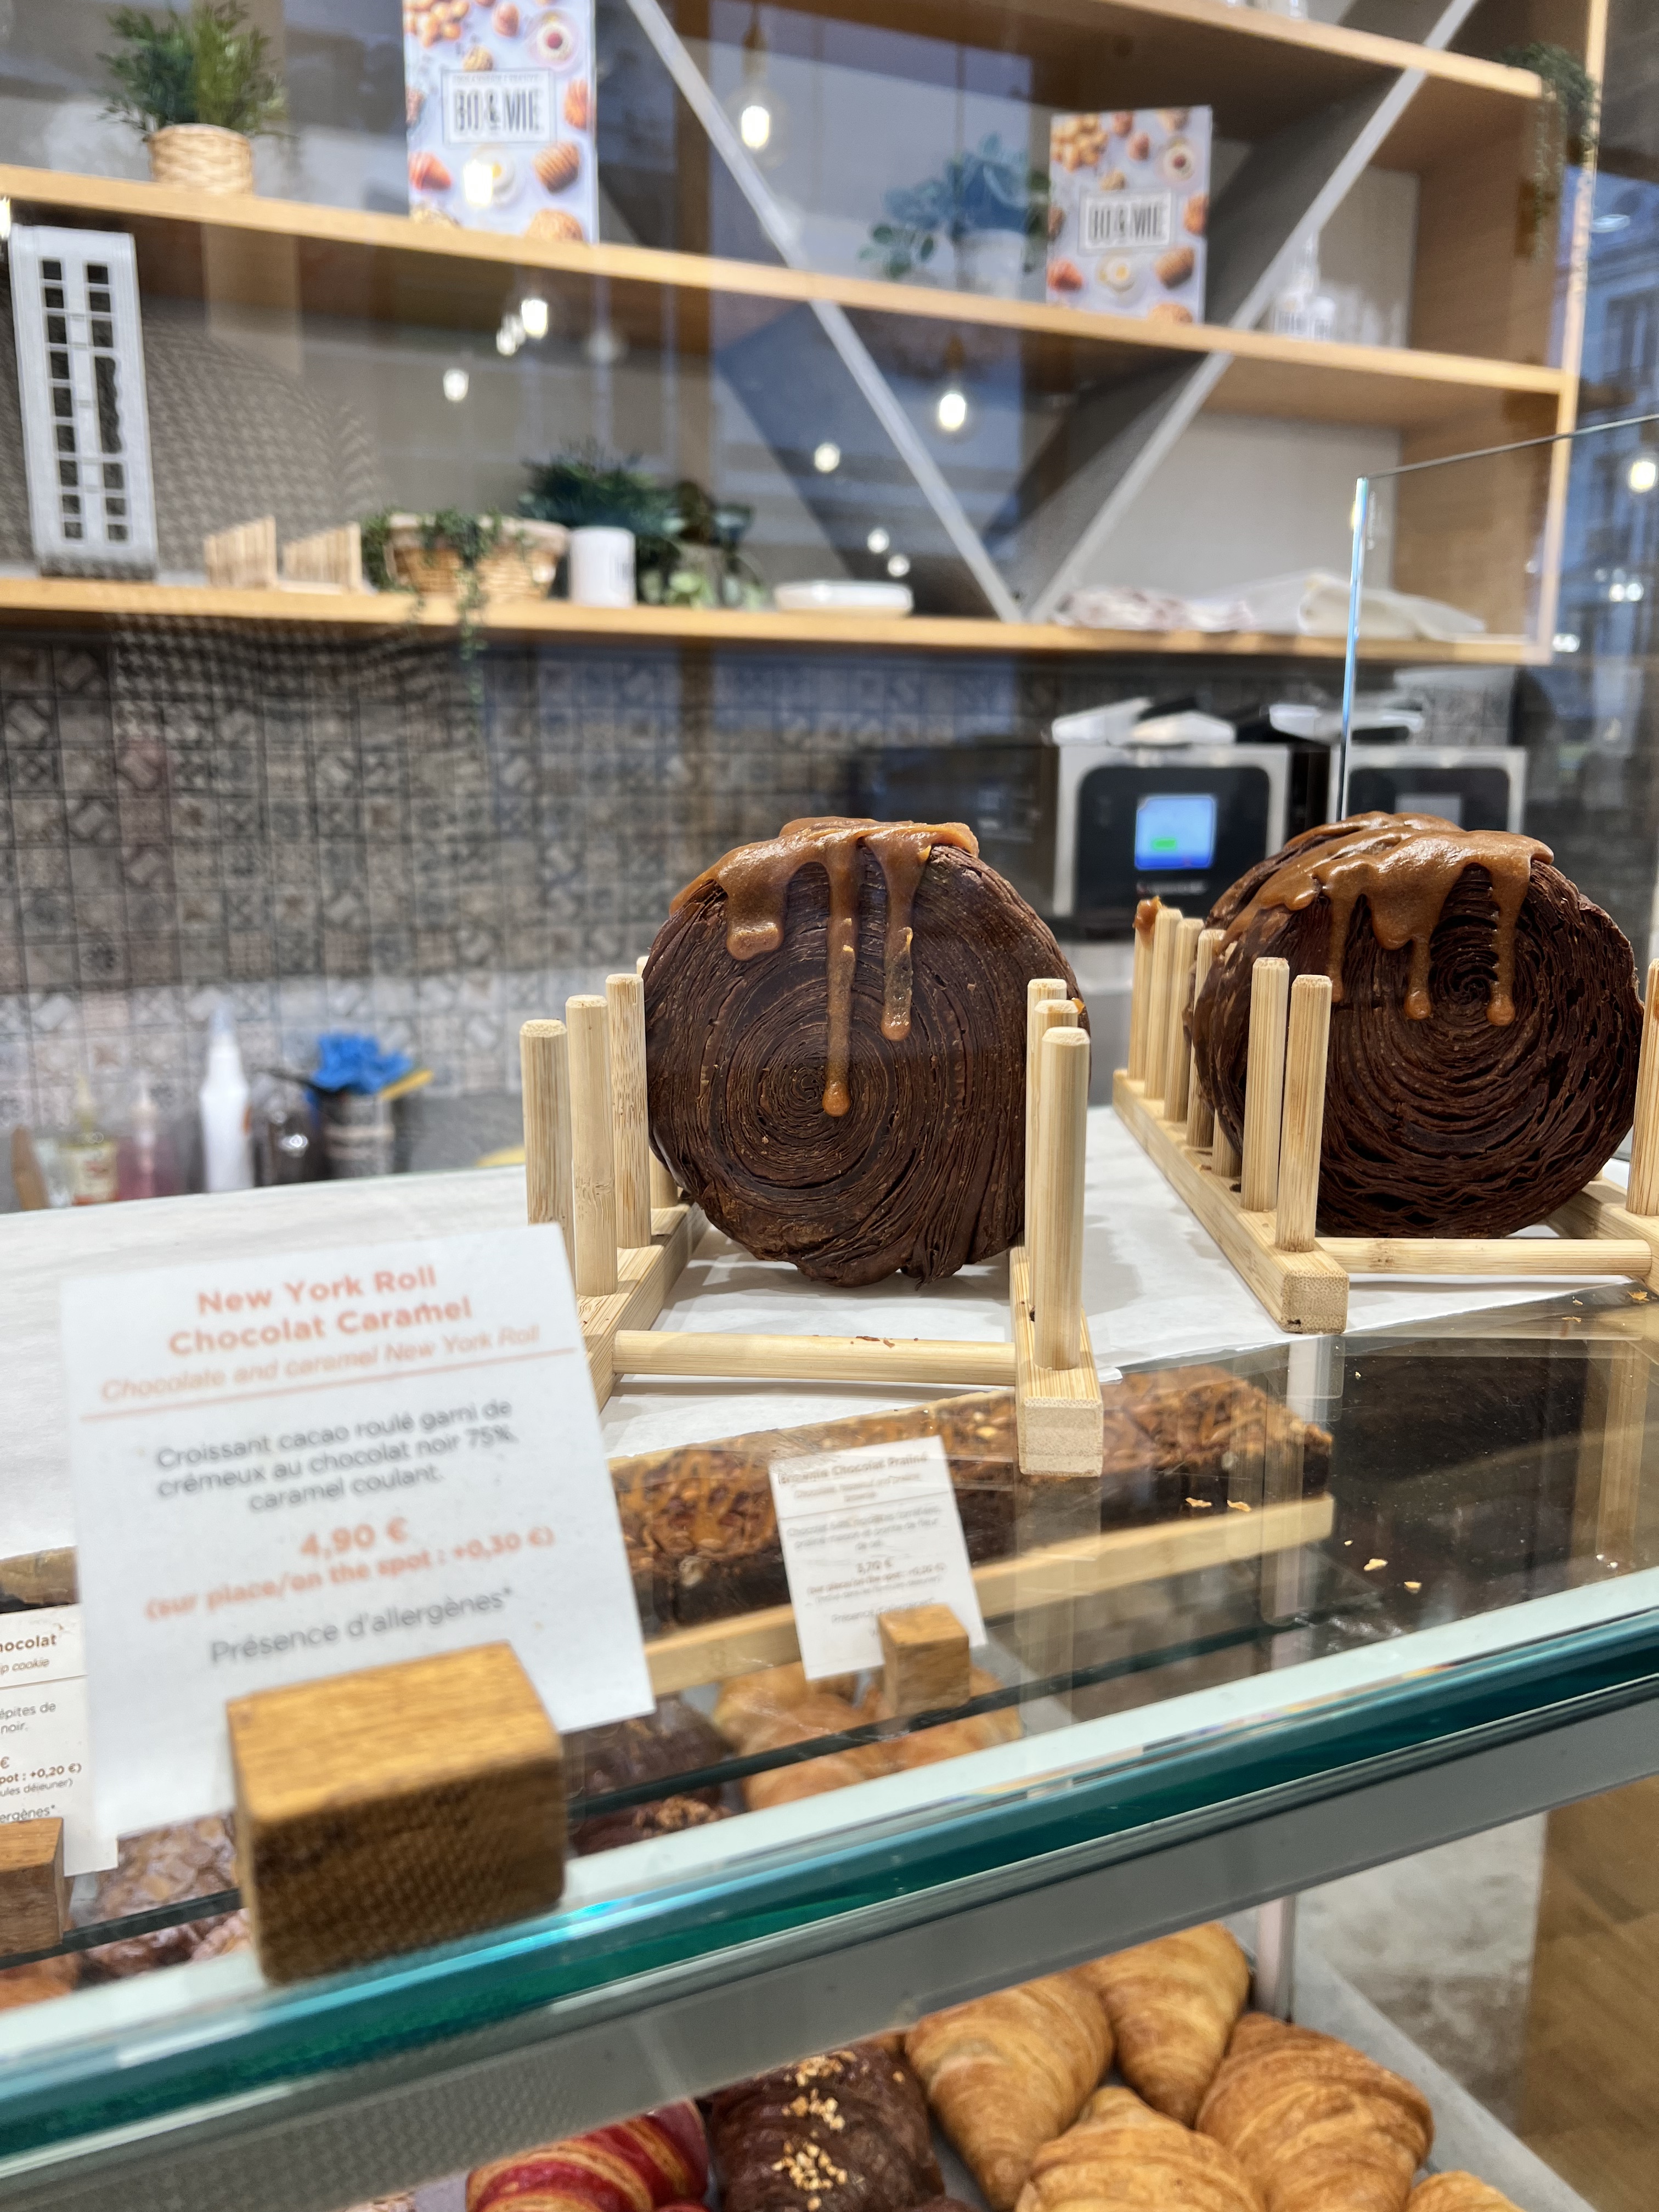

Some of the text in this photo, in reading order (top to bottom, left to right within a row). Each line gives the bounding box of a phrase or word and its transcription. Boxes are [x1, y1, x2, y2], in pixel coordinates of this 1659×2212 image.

[198, 1264, 437, 1316] New York Roll
[168, 1295, 473, 1357] Chocolat Caramel
[100, 1324, 540, 1401] Chocolate and caramel New York Roll
[156, 1398, 513, 1471] Croissant cacao roulé garni de
[157, 1466, 266, 1498] crémeux
[273, 1461, 302, 1480] au
[308, 1441, 412, 1475] chocolat
[415, 1433, 461, 1457] noir
[249, 1476, 345, 1513] caramel
[300, 1516, 409, 1560] 4,90 €
[145, 1594, 198, 1623] (sur
[330, 1563, 370, 1583] the
[377, 1549, 432, 1578] spot
[12, 1657, 50, 1672] cookie
[210, 1624, 339, 1666] Présence
[0, 1701, 57, 1720] épites de
[0, 1773, 19, 1786] pot
[30, 1764, 65, 1779] +0,20
[67, 1762, 82, 1774] €)
[1, 1756, 10, 1769] €
[0, 1786, 21, 1797] ules
[0, 1804, 55, 1824] ergènes
